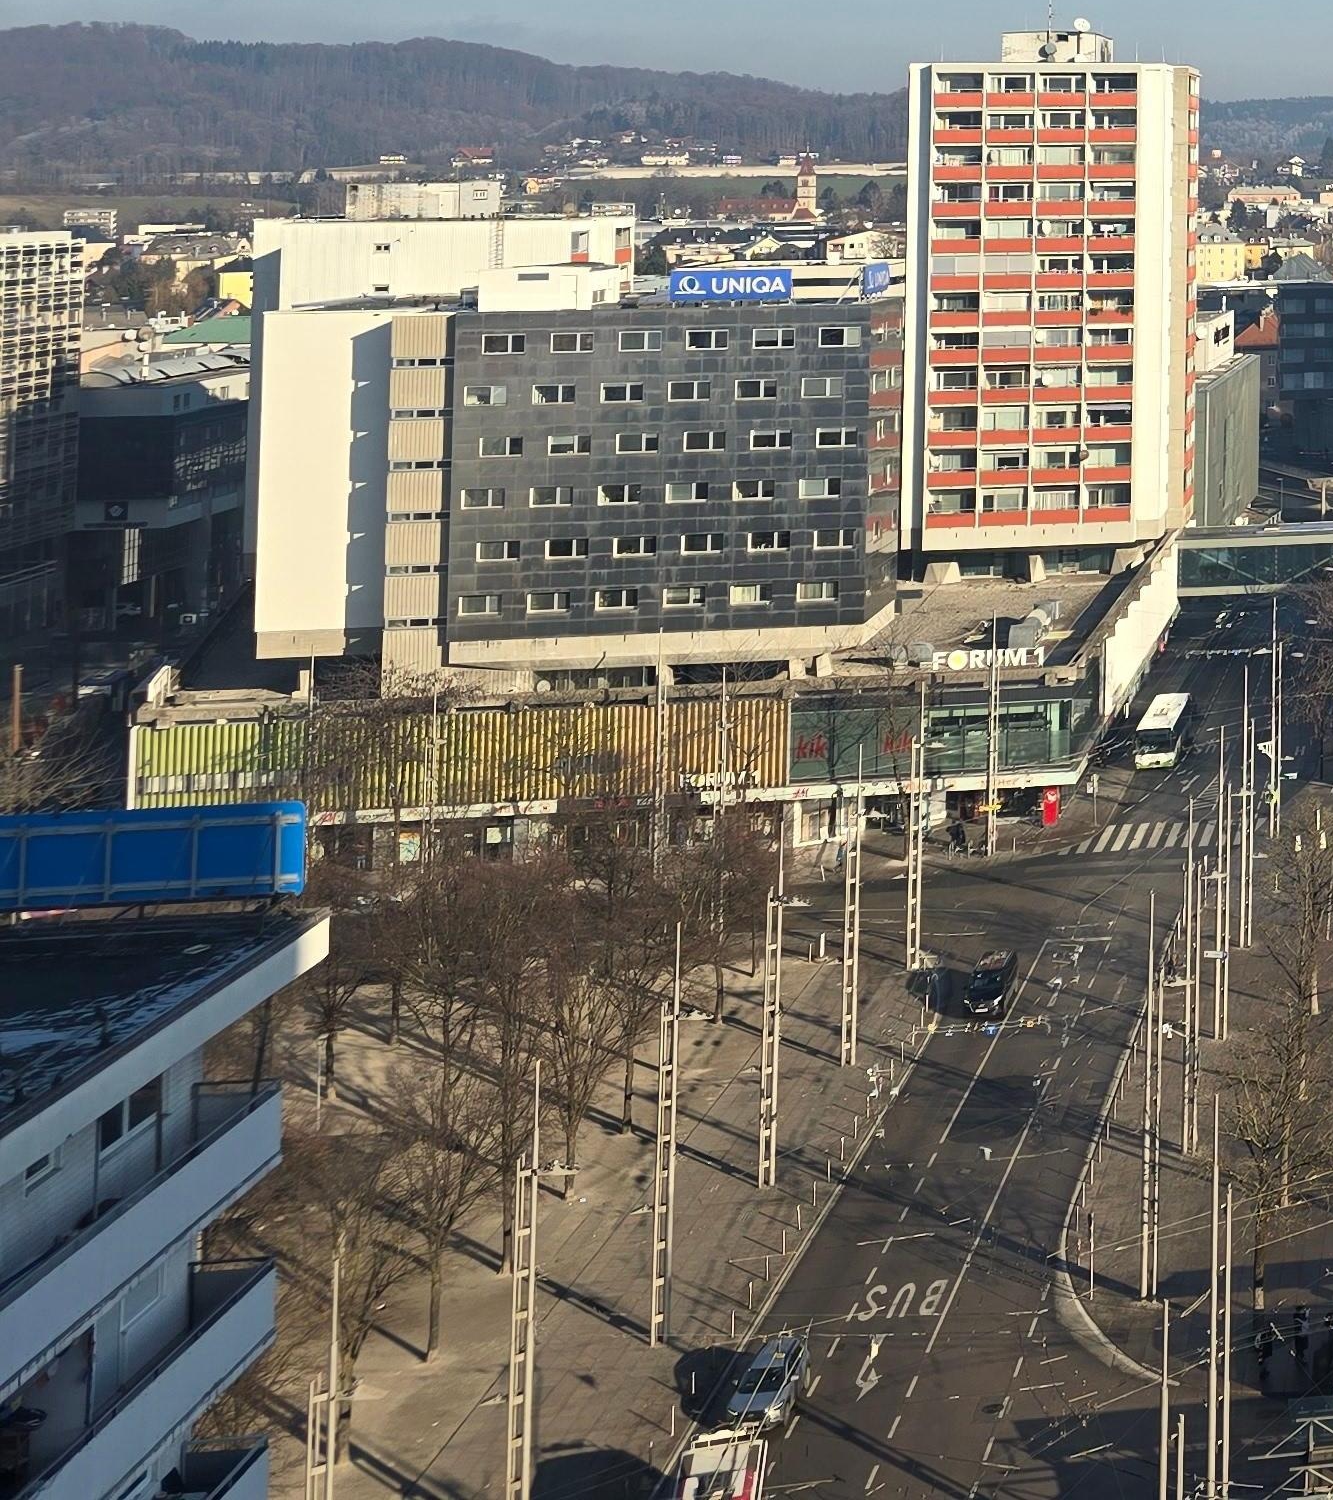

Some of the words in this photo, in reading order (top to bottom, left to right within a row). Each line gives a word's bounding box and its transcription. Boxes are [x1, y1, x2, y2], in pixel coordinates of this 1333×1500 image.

[711, 276, 786, 295] UNIQA
[932, 648, 1027, 671] FORUM
[1033, 646, 1045, 668] 1
[858, 1280, 948, 1321] BUS
